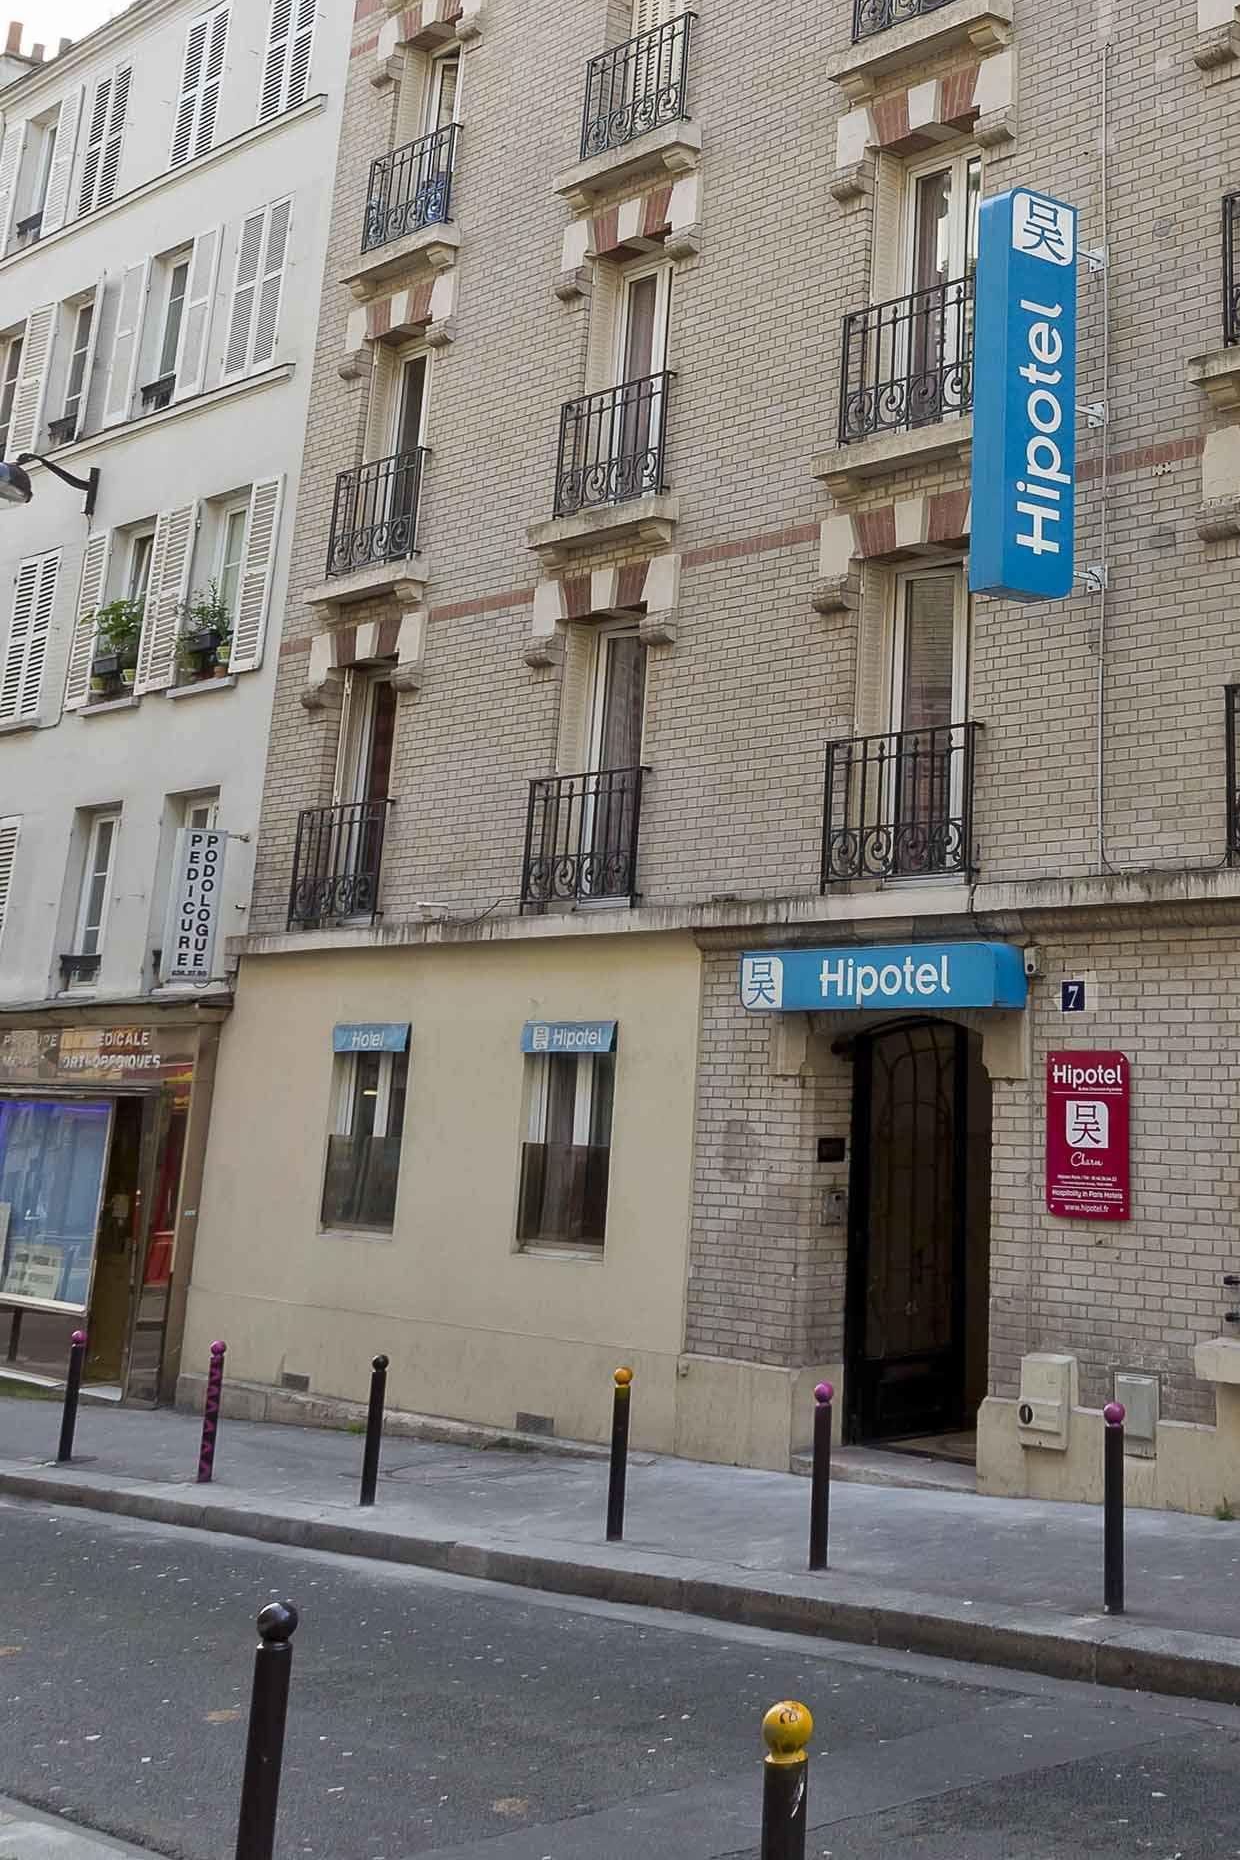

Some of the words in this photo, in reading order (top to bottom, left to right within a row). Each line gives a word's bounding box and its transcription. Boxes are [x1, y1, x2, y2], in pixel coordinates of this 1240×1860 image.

[1016, 298, 1071, 555] Hipotel
[177, 834, 203, 967] PEDICURE
[193, 834, 219, 967] PODOLOGUE
[819, 955, 951, 1006] Hipotel
[1067, 985, 1080, 1009] 7
[92, 1030, 150, 1047] EDICALE
[352, 1030, 385, 1048] Hotel
[552, 1027, 602, 1049] Hipotel
[1053, 1064, 1123, 1089] Hipotel
[1064, 1203, 1110, 1213] www.hipotel.fr
